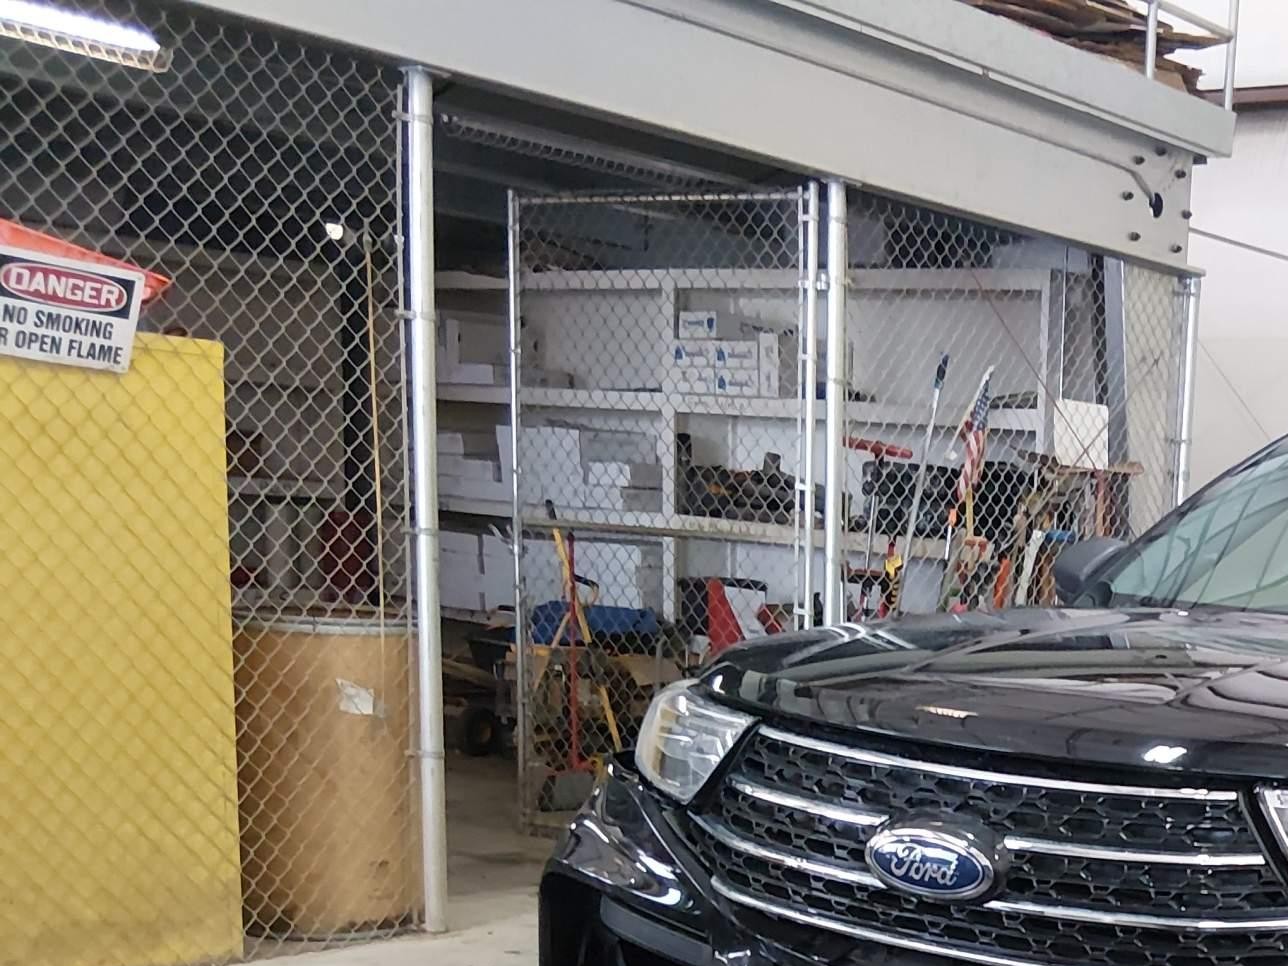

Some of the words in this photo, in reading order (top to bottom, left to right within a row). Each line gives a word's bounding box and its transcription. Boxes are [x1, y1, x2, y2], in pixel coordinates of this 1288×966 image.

[9, 266, 120, 307] DANGER
[2, 304, 28, 325] NO
[34, 310, 114, 340] SMOKING
[0, 327, 8, 346] R
[14, 330, 62, 355] OPEN
[67, 339, 123, 365] FLAME
[889, 843, 959, 886] Ford
